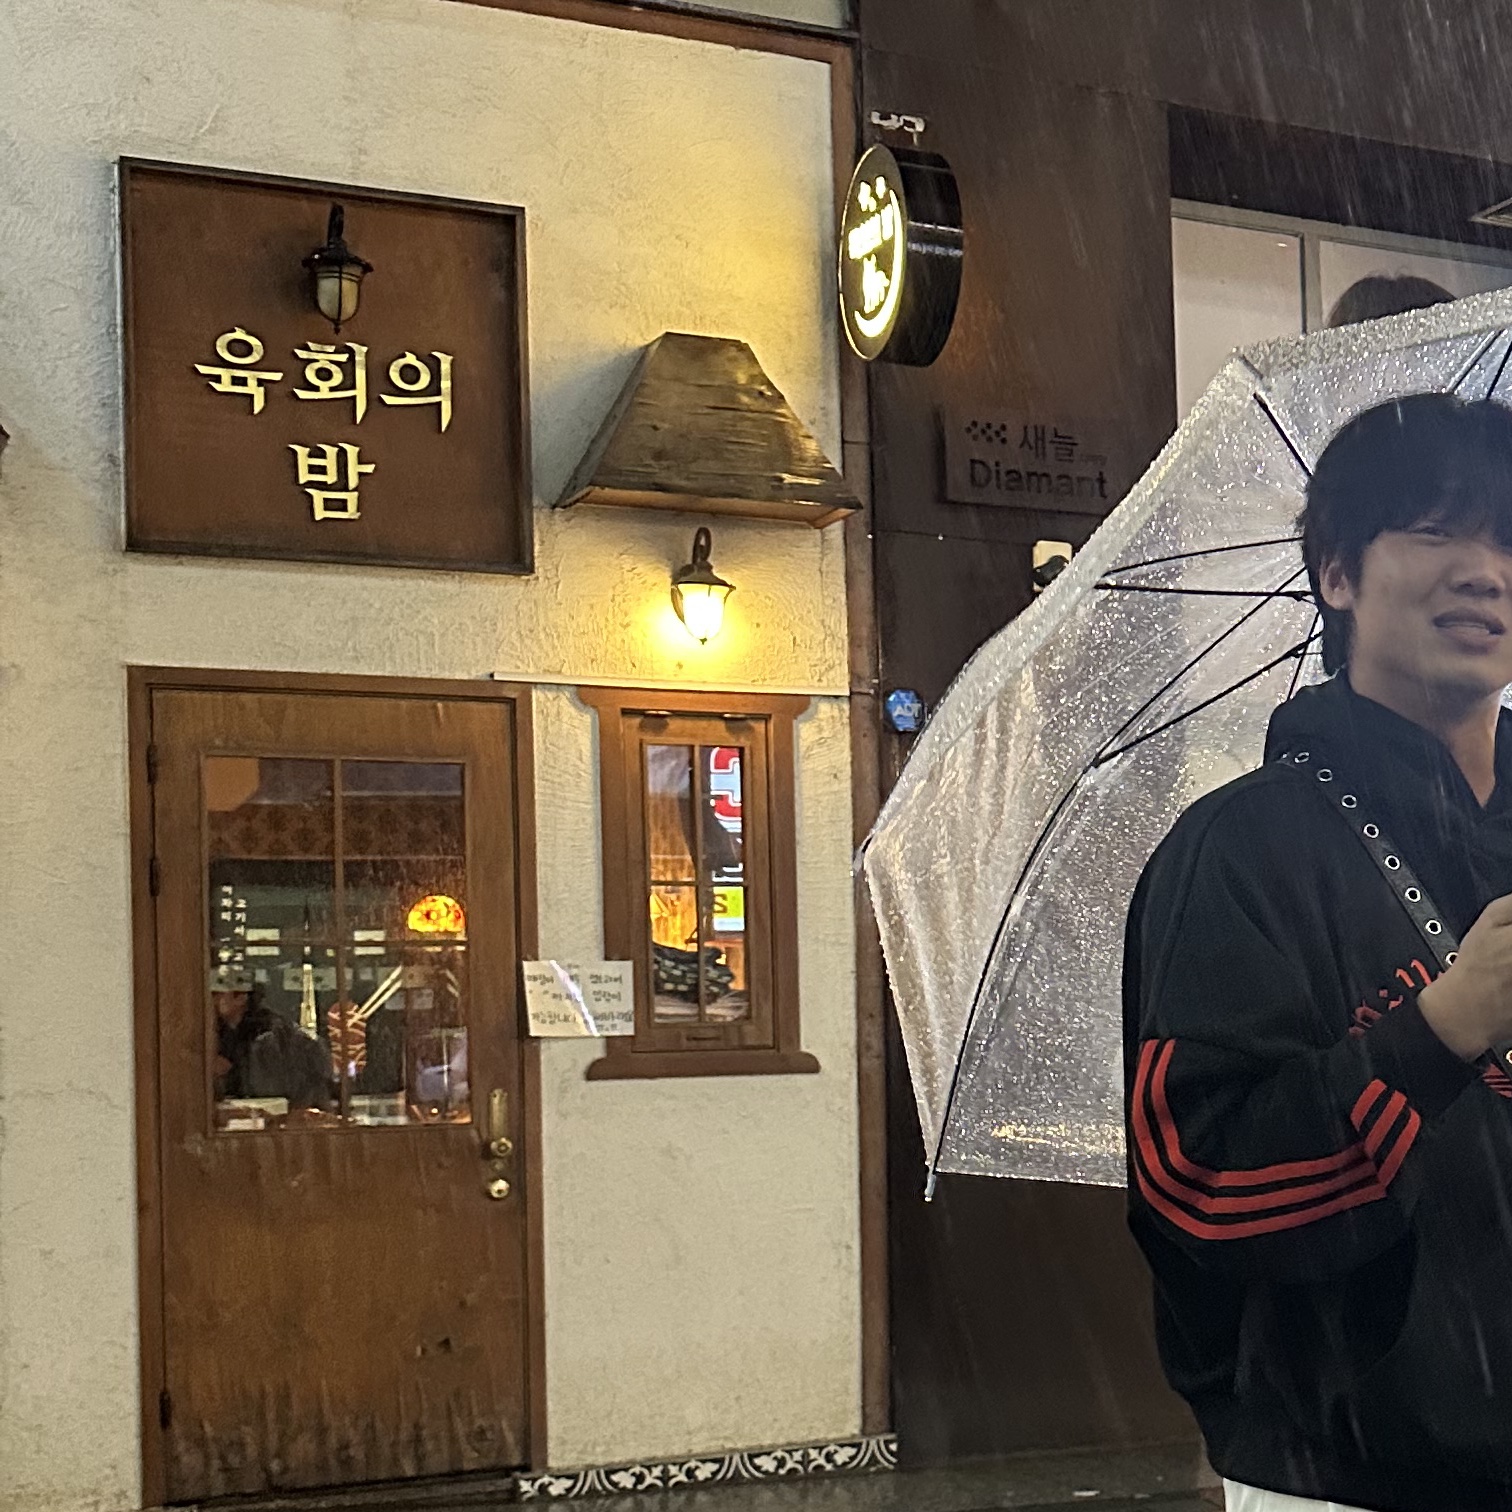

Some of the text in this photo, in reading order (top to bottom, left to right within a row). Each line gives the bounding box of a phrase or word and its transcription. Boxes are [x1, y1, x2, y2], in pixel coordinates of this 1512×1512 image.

[194, 326, 454, 433] 육회의
[287, 442, 376, 521] 밤
[969, 458, 1107, 499] Diamant
[893, 703, 921, 718] ADT
